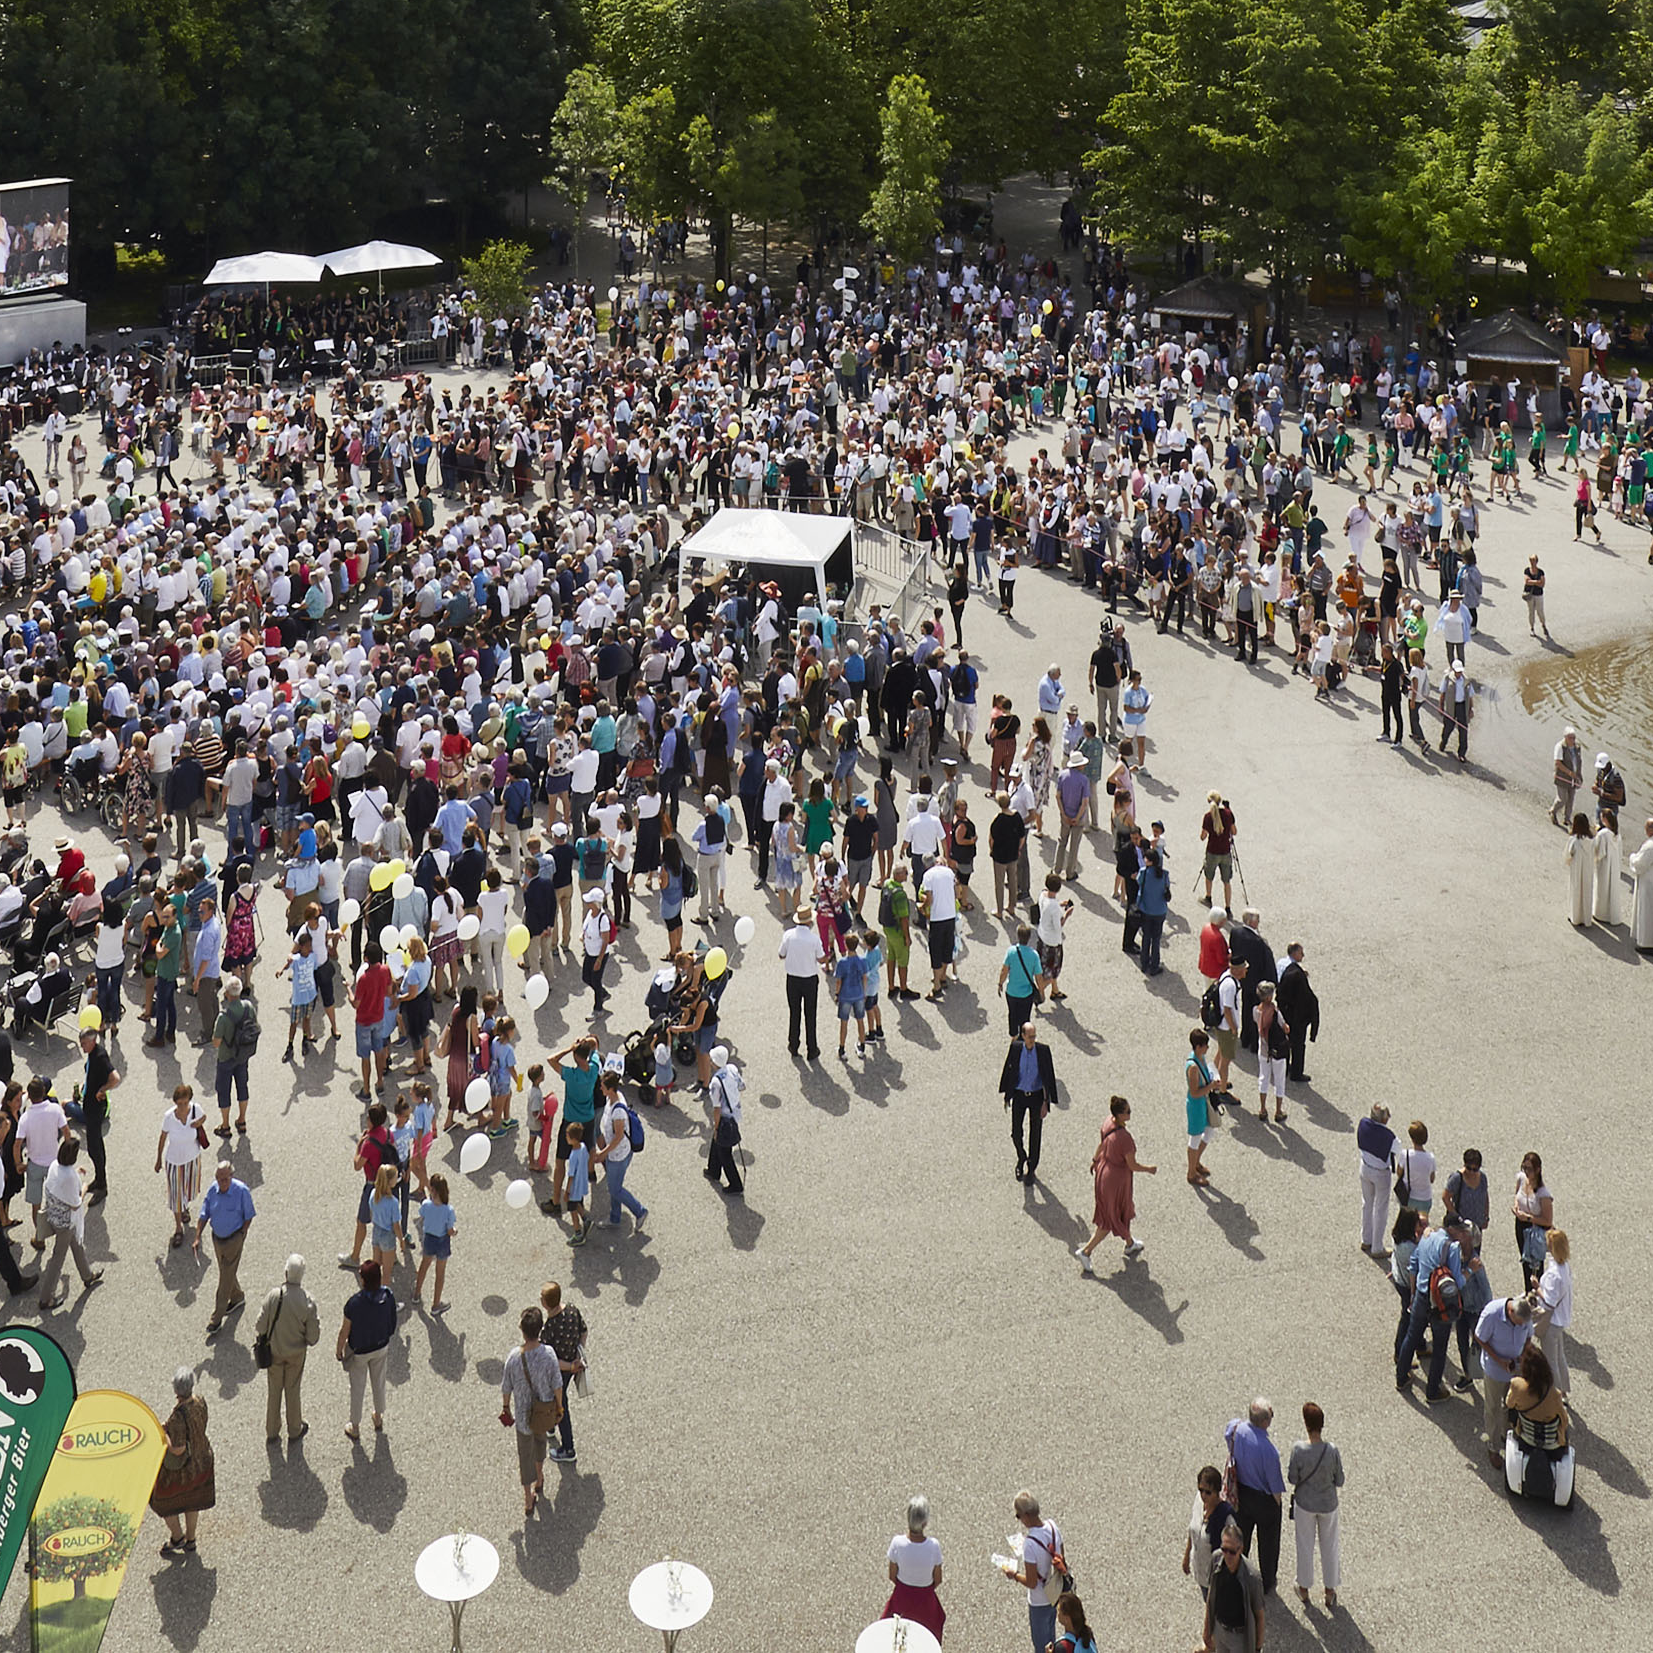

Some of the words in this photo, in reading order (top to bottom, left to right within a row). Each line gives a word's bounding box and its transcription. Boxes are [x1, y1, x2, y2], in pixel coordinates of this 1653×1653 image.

[76, 1428, 131, 1448] RAUCH
[10, 1426, 31, 1471] Bier
[62, 1533, 105, 1549] RAUCH
